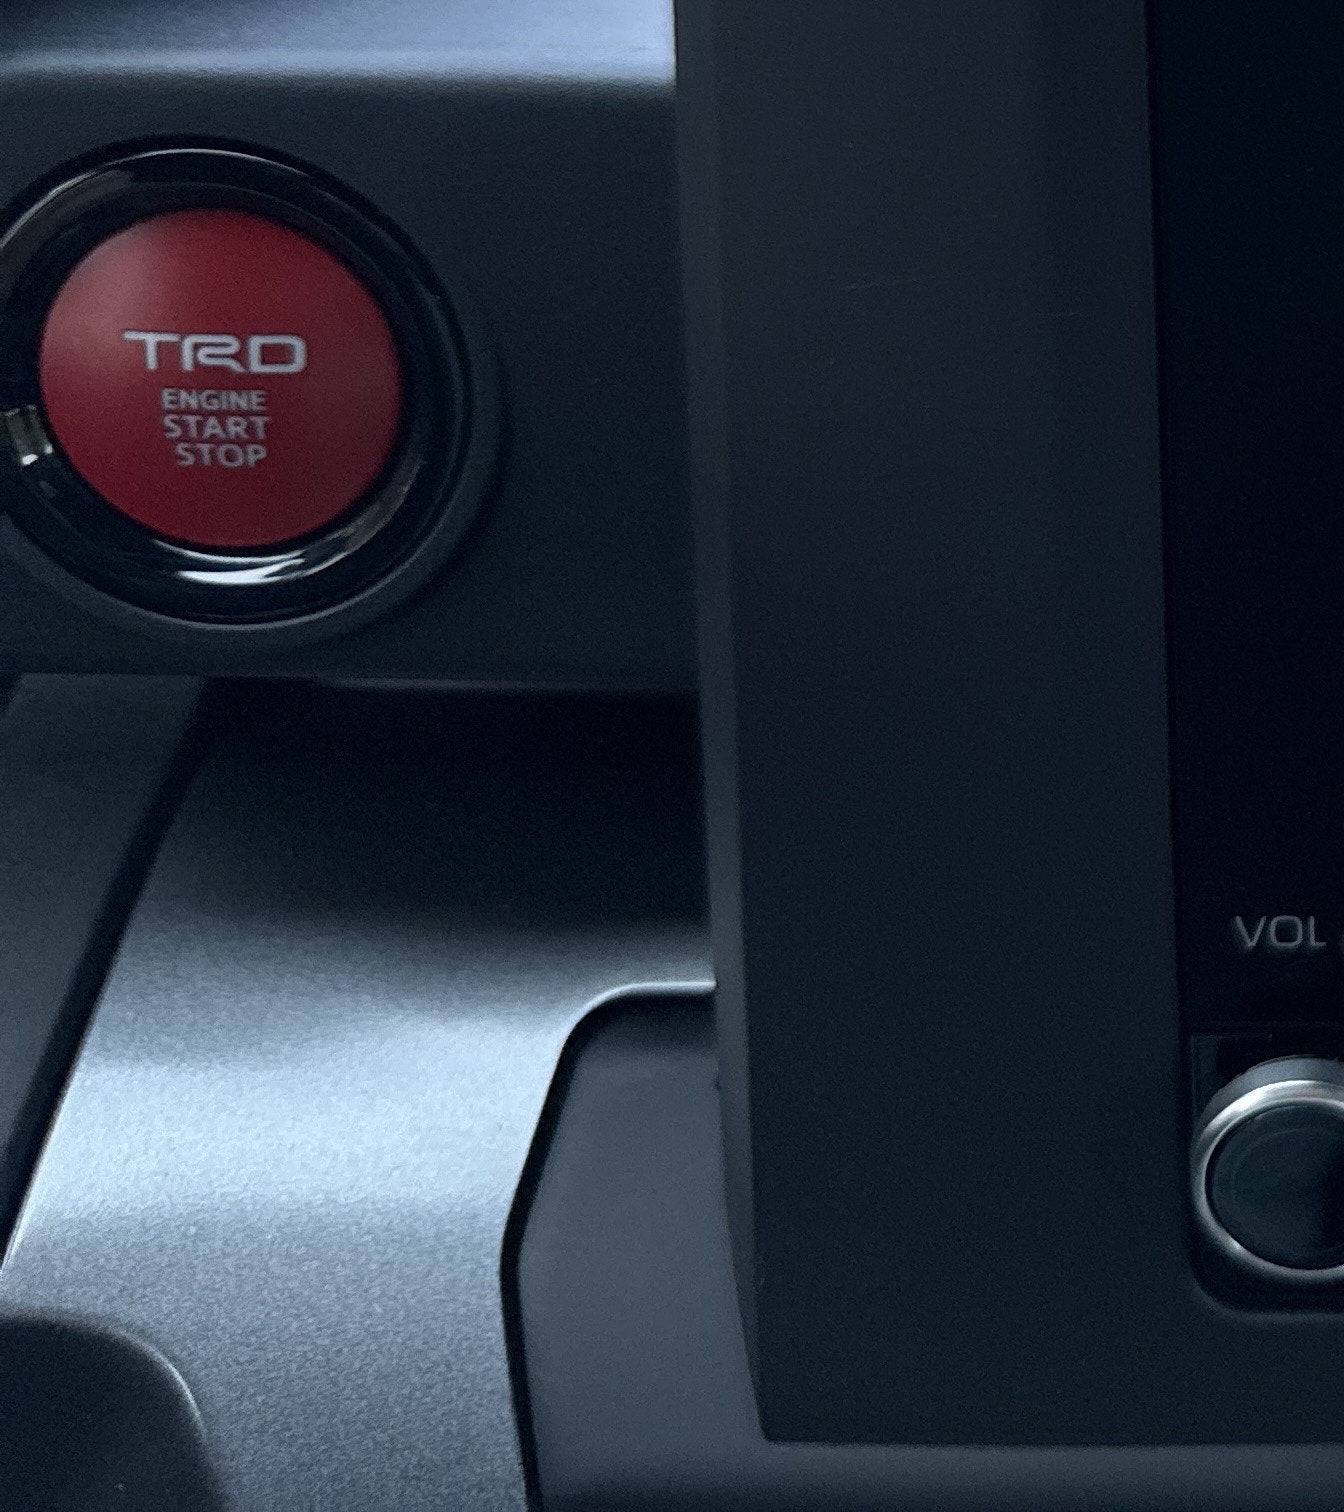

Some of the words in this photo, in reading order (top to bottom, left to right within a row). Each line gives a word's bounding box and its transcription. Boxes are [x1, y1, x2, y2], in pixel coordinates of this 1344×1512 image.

[123, 331, 304, 372] TRD
[160, 389, 268, 412] ENGINE
[163, 416, 270, 439] START
[175, 444, 268, 468] STOP
[1234, 915, 1327, 948] VOL
